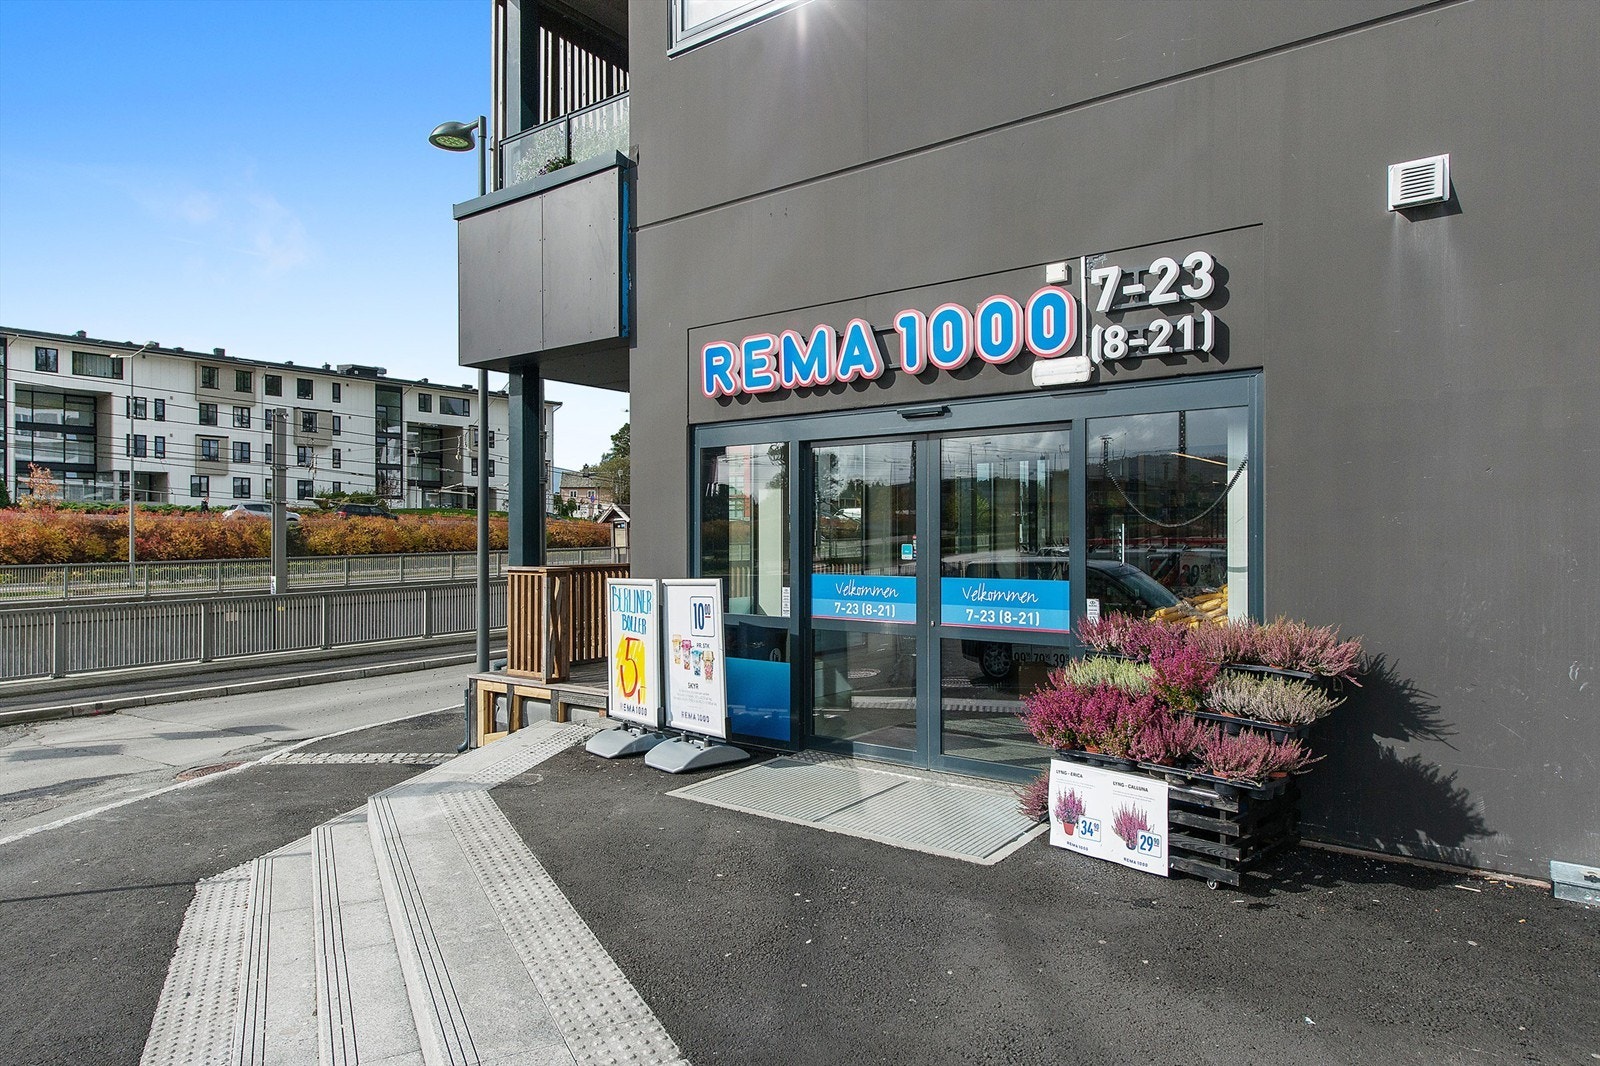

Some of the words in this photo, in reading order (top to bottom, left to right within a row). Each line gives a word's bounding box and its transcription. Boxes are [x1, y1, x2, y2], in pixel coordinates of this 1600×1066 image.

[1091, 251, 1215, 313] 7-23
[702, 318, 883, 398] REMA
[894, 285, 1077, 375] 1000
[1091, 309, 1215, 364] (8-21)
[835, 579, 900, 598] Velkommen
[962, 583, 1039, 603] Velkommen
[611, 585, 652, 615] BERLINER
[834, 602, 860, 615] 7-23
[861, 603, 897, 618] (8-21)
[693, 602, 705, 630] 10
[965, 608, 996, 624] 7-23
[998, 610, 1041, 627] (8-21)
[1081, 820, 1094, 837] 34
[1140, 834, 1153, 852] 29
